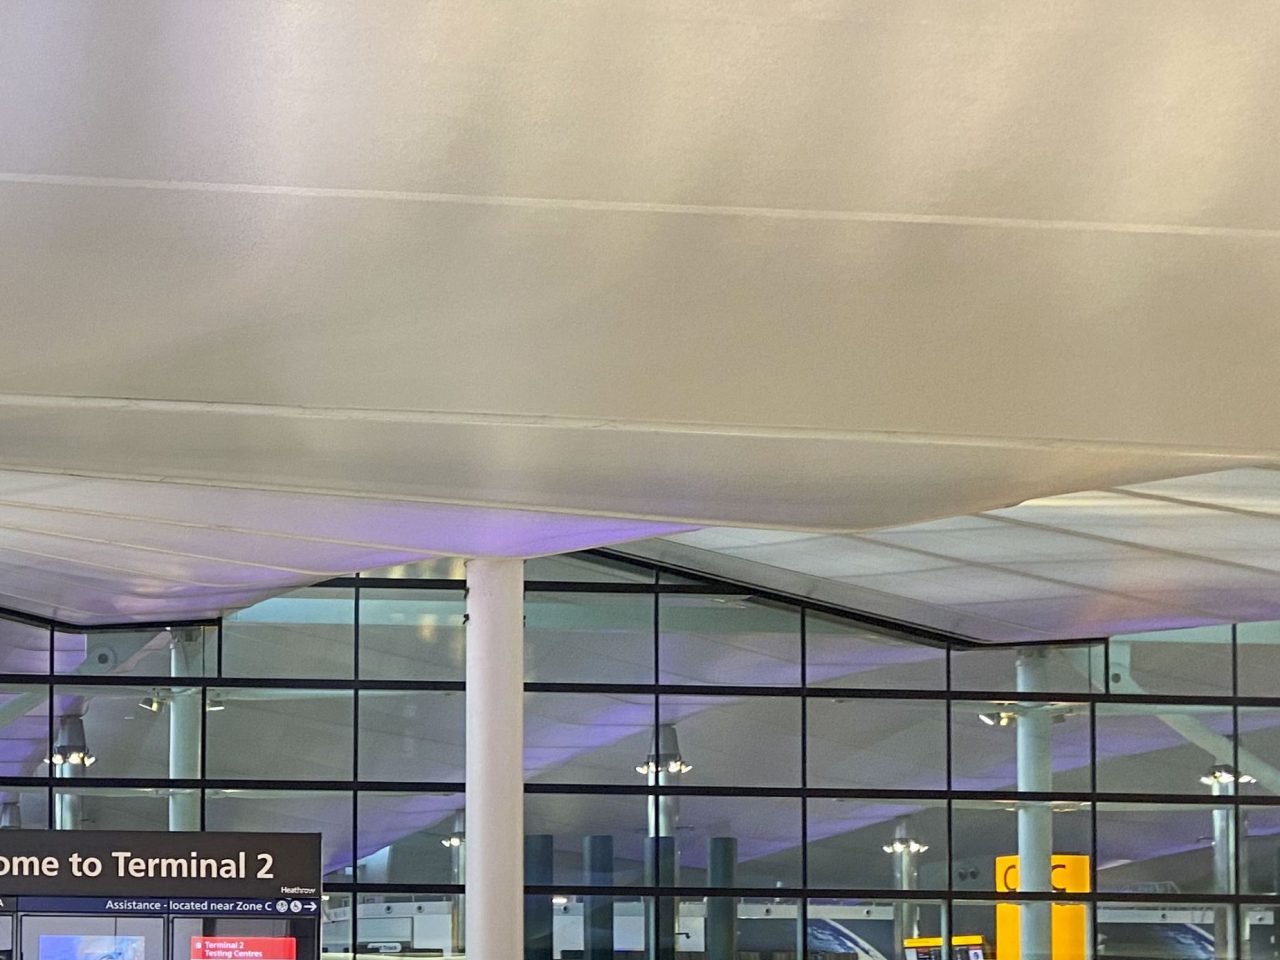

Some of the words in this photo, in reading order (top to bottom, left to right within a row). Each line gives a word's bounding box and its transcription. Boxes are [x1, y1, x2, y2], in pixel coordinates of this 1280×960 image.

[68, 852, 102, 877] to
[111, 851, 247, 879] Terminal
[256, 853, 274, 879] 2
[280, 886, 316, 894] Heathrow
[105, 900, 160, 911] Assistance
[169, 900, 208, 911] located
[210, 903, 235, 912] near
[236, 902, 262, 912] Zone
[264, 902, 272, 912] C
[205, 941, 238, 949] Terminal
[239, 941, 245, 949] 2
[205, 950, 232, 959] Testing
[234, 949, 263, 957] Centres
